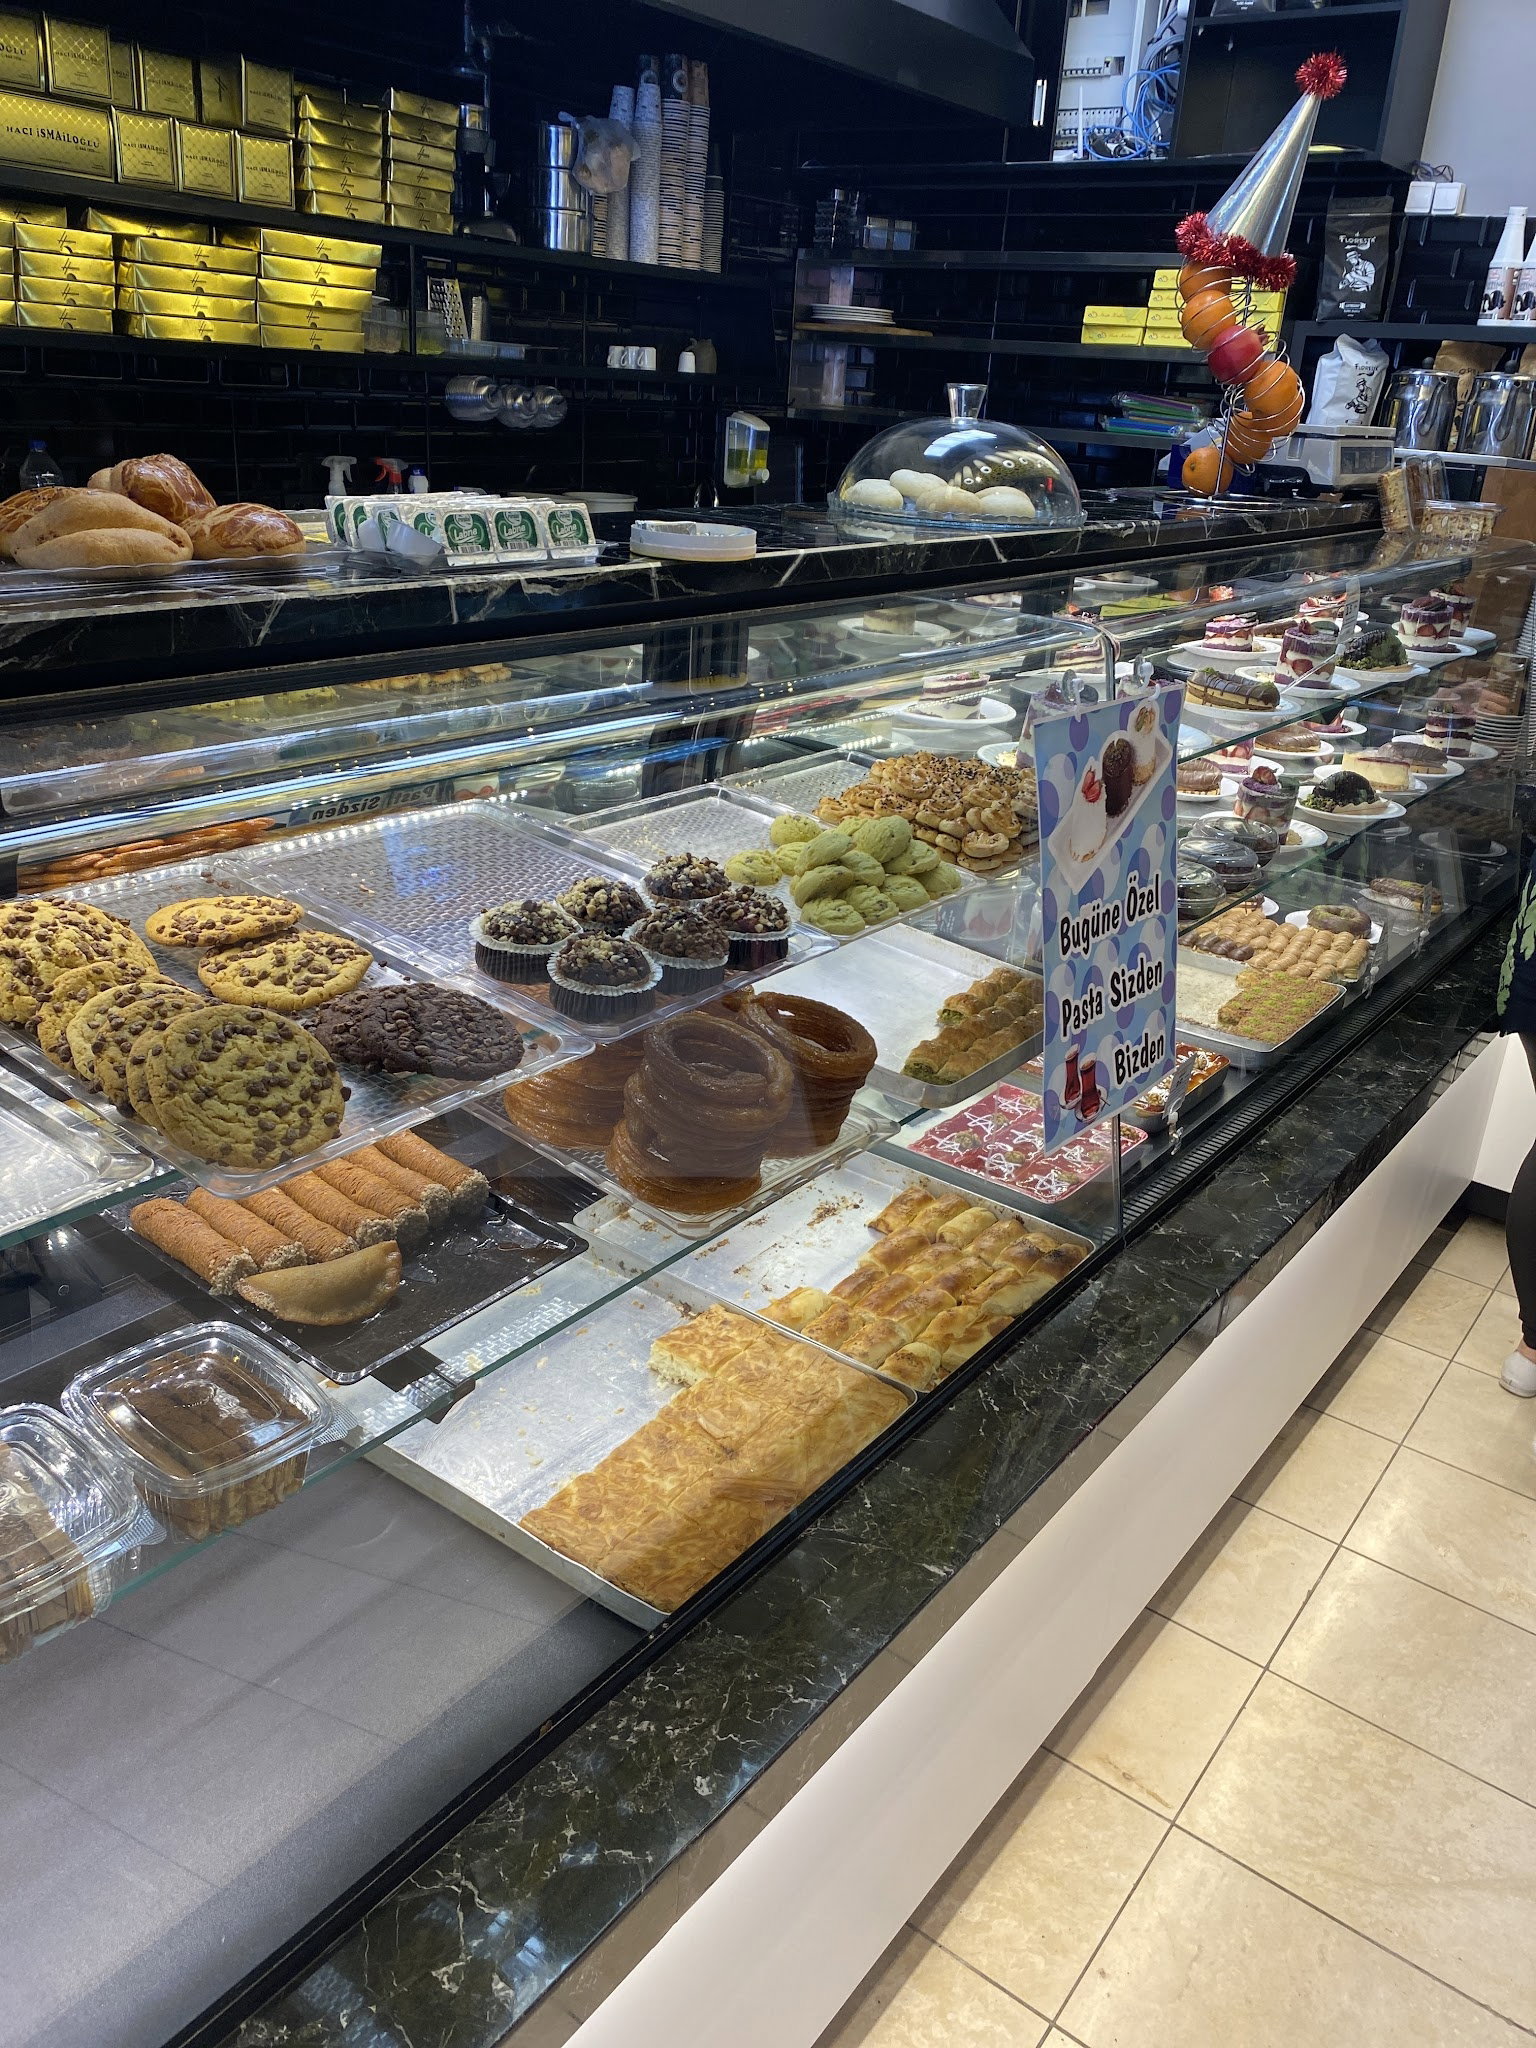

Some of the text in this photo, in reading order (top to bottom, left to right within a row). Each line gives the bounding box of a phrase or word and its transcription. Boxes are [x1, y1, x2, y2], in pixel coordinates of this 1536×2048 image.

[6, 126, 33, 136] HACI
[453, 528, 478, 541] Labne
[503, 524, 526, 537] Labne
[556, 523, 578, 535] Labne
[1060, 874, 1160, 955] Bugüne Özel
[1062, 957, 1163, 1037] Pasta Sizden
[1114, 1033, 1164, 1085] Bizden
